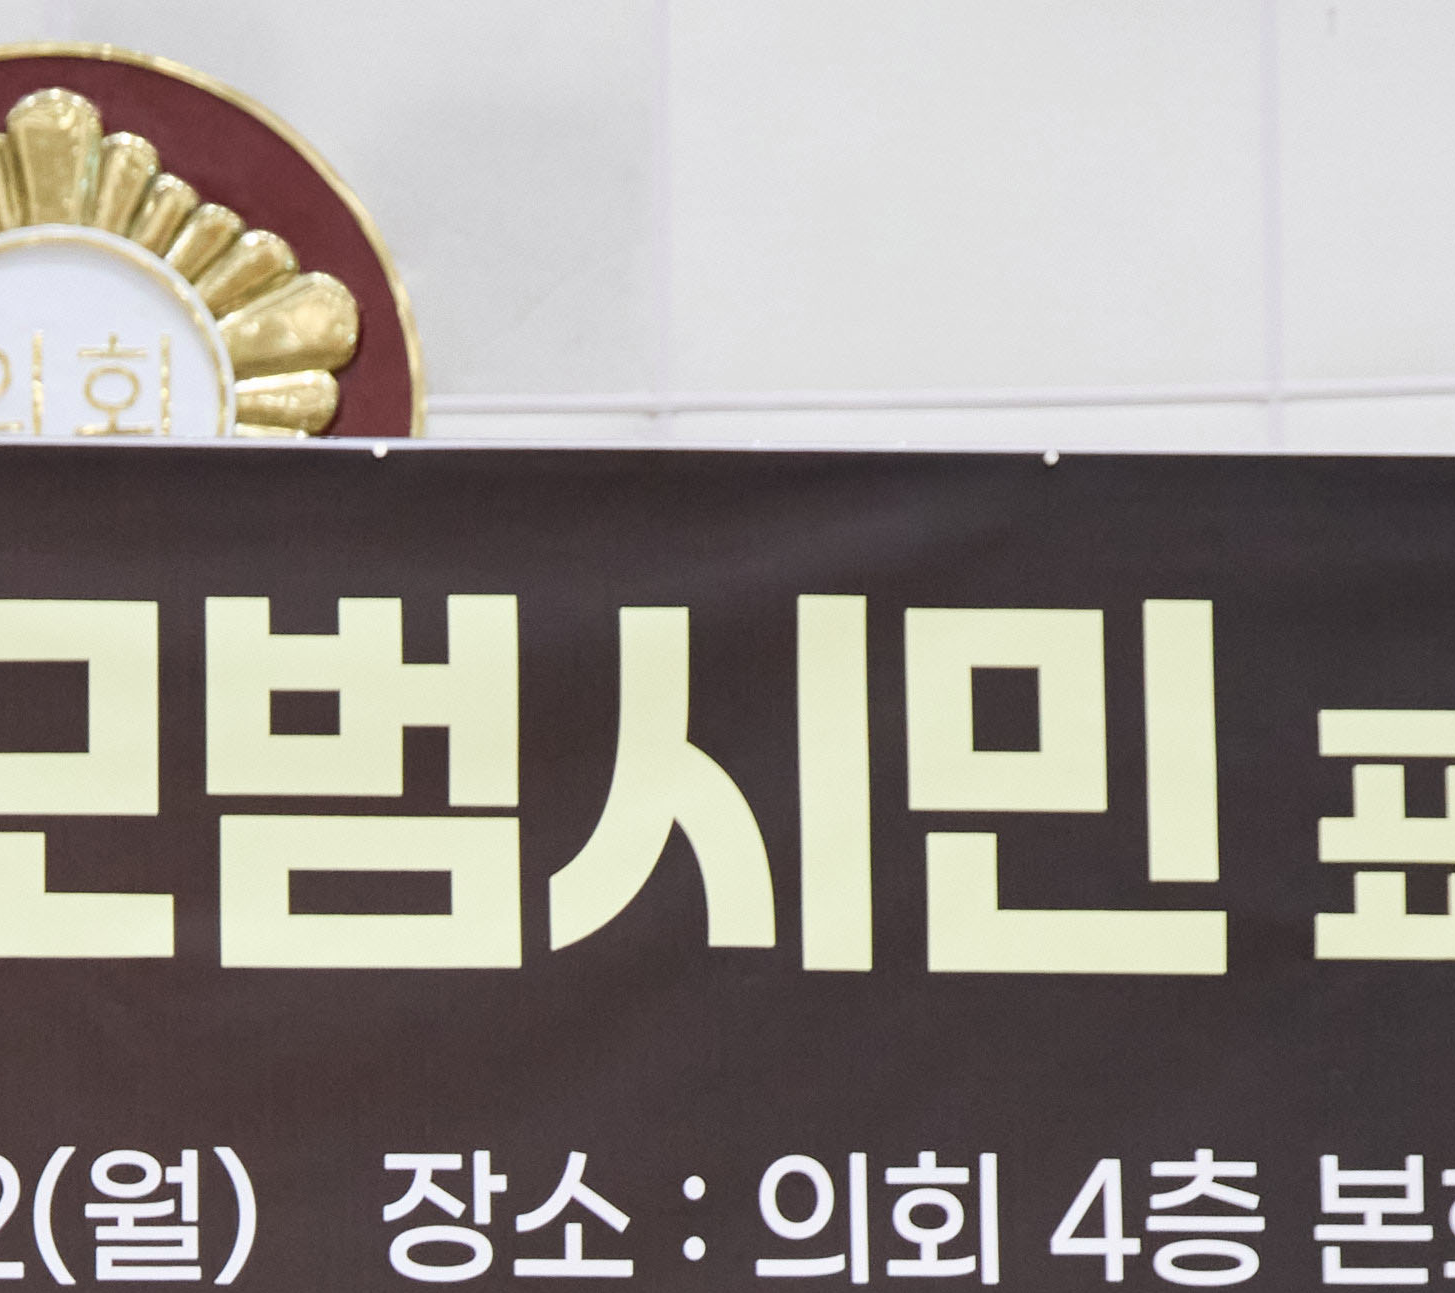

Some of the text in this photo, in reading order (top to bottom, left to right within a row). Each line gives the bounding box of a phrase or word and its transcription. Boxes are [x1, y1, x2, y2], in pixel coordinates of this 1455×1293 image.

[382, 1149, 634, 1283] 장소
[682, 1175, 707, 1261] :
[755, 1150, 1000, 1285] 의회
[1049, 1148, 1266, 1287] 4층
